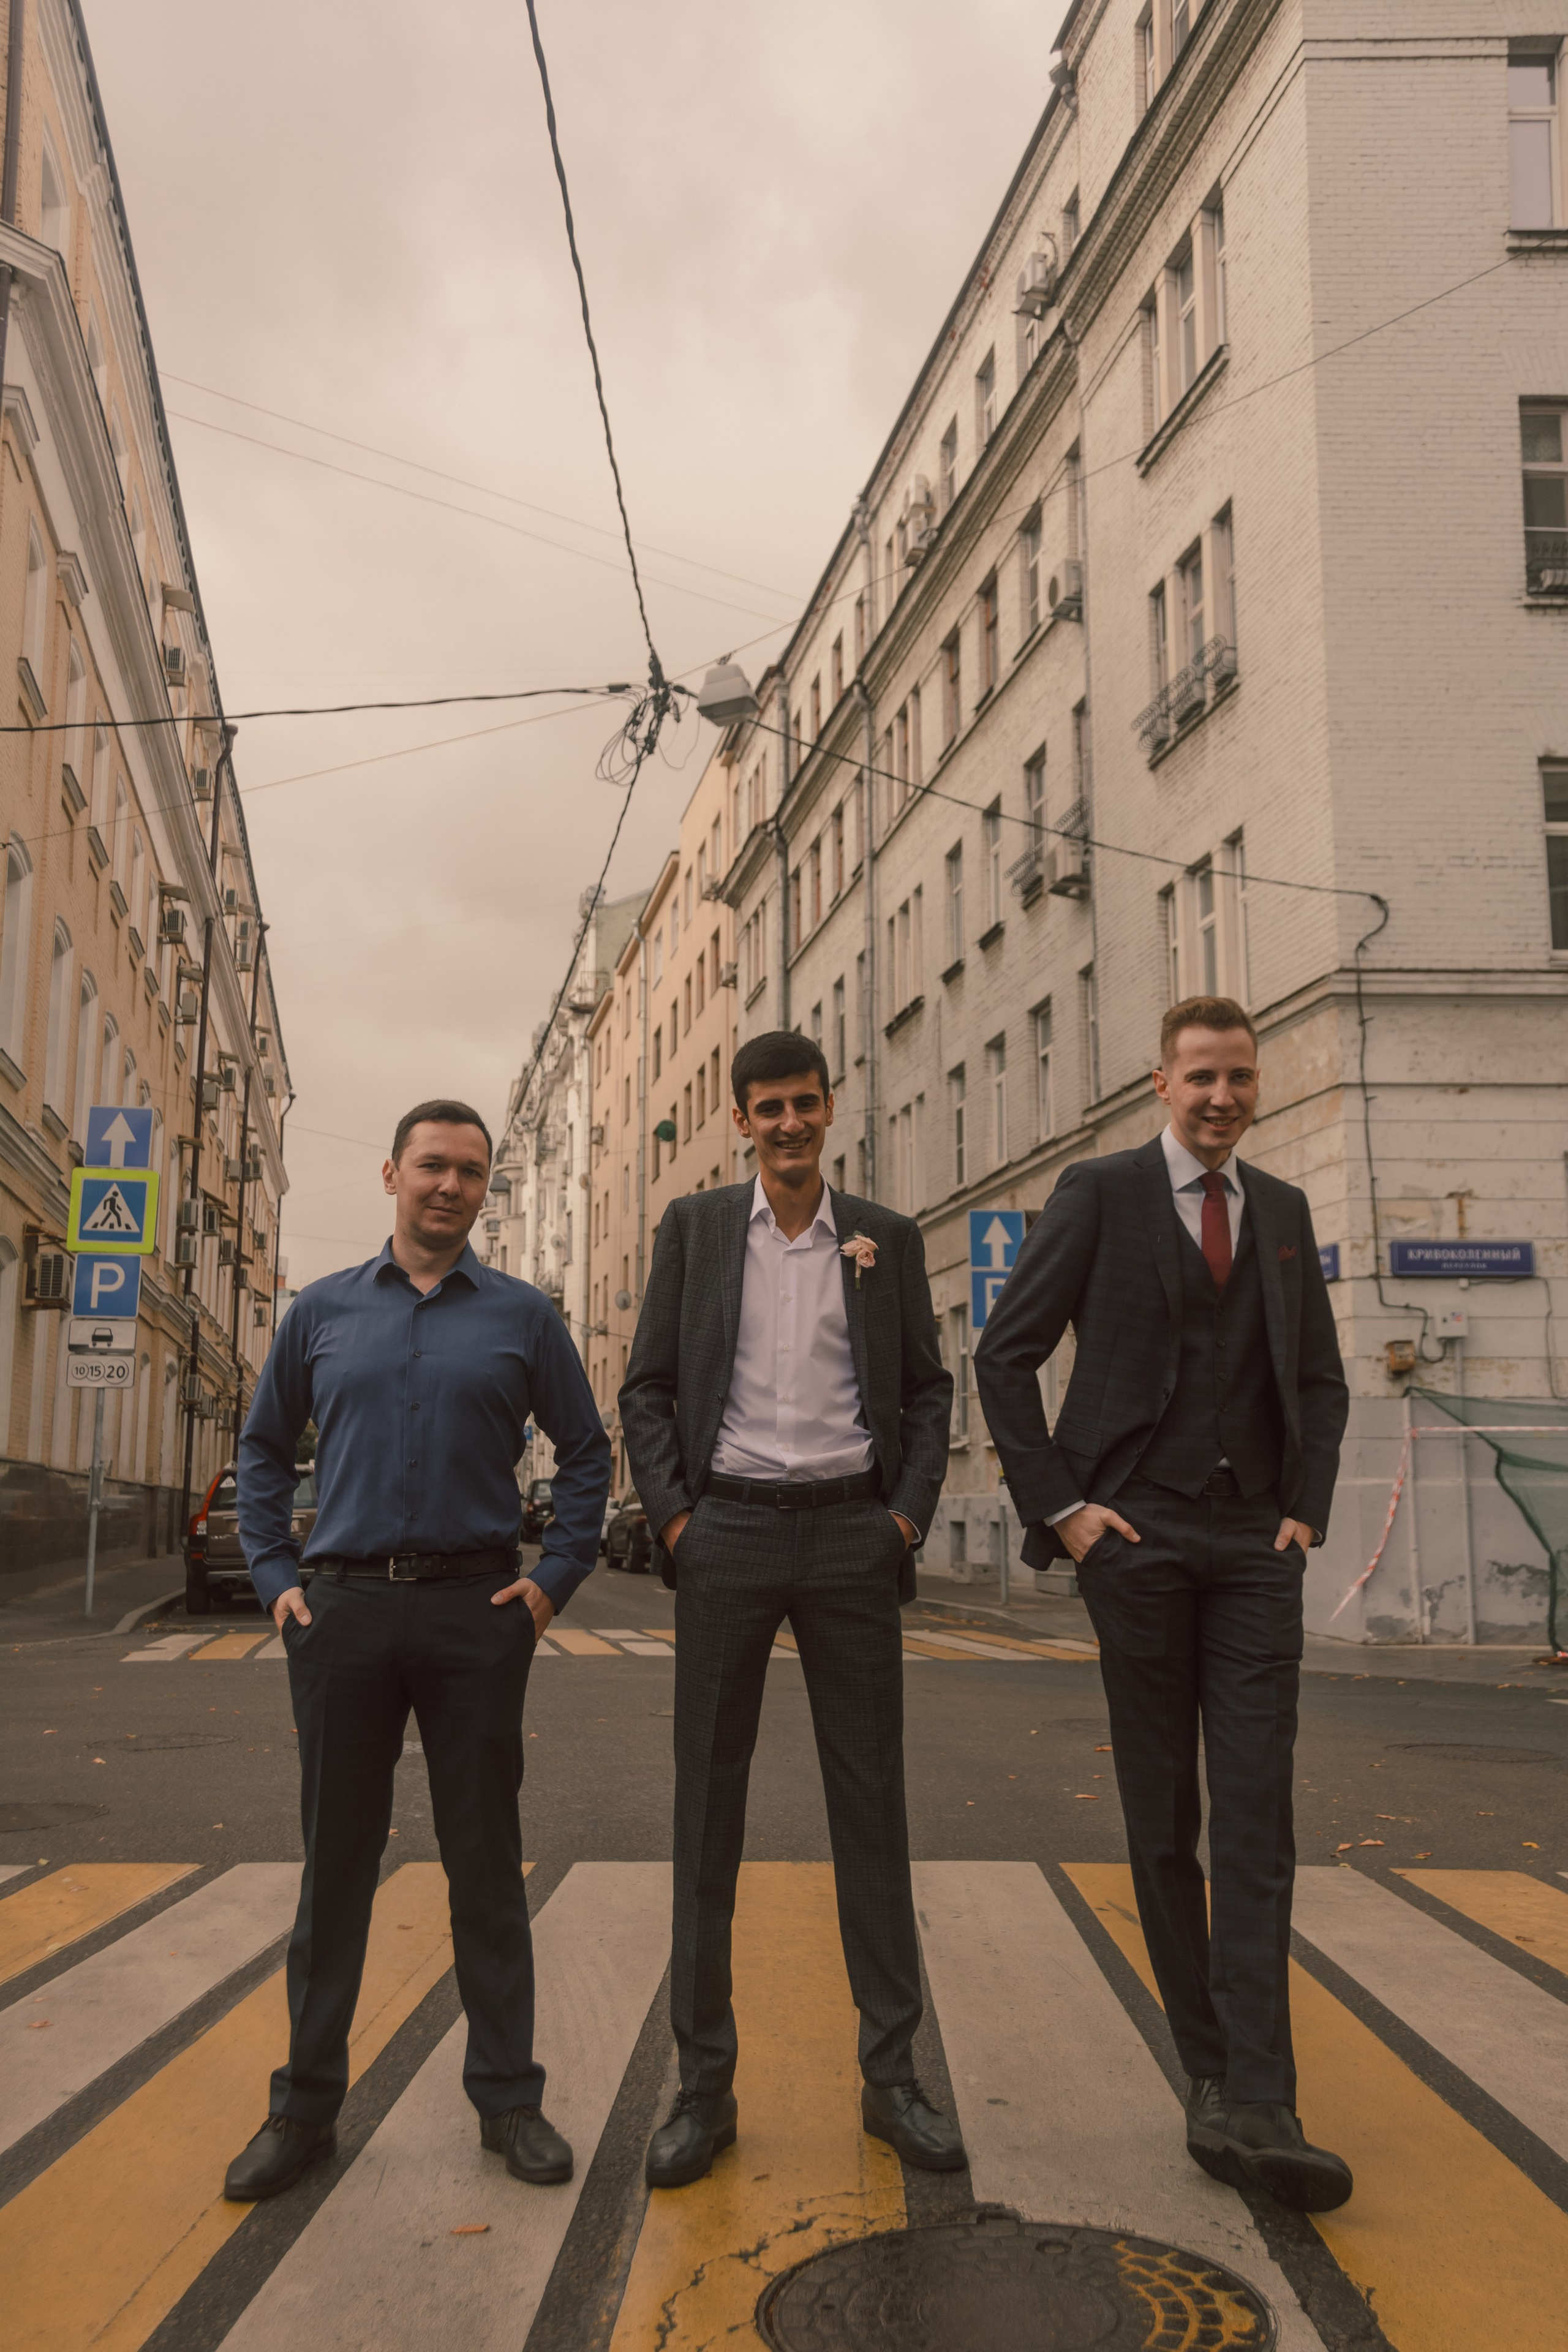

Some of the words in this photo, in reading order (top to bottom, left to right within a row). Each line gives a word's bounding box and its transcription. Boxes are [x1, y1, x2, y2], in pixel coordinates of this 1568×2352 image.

[1408, 1247, 1521, 1260] КРИВОКОЛЕННЫЙ
[90, 1262, 125, 1308] P
[75, 1366, 85, 1375] 10
[89, 1365, 101, 1377] 15
[106, 1365, 126, 1378] 20
